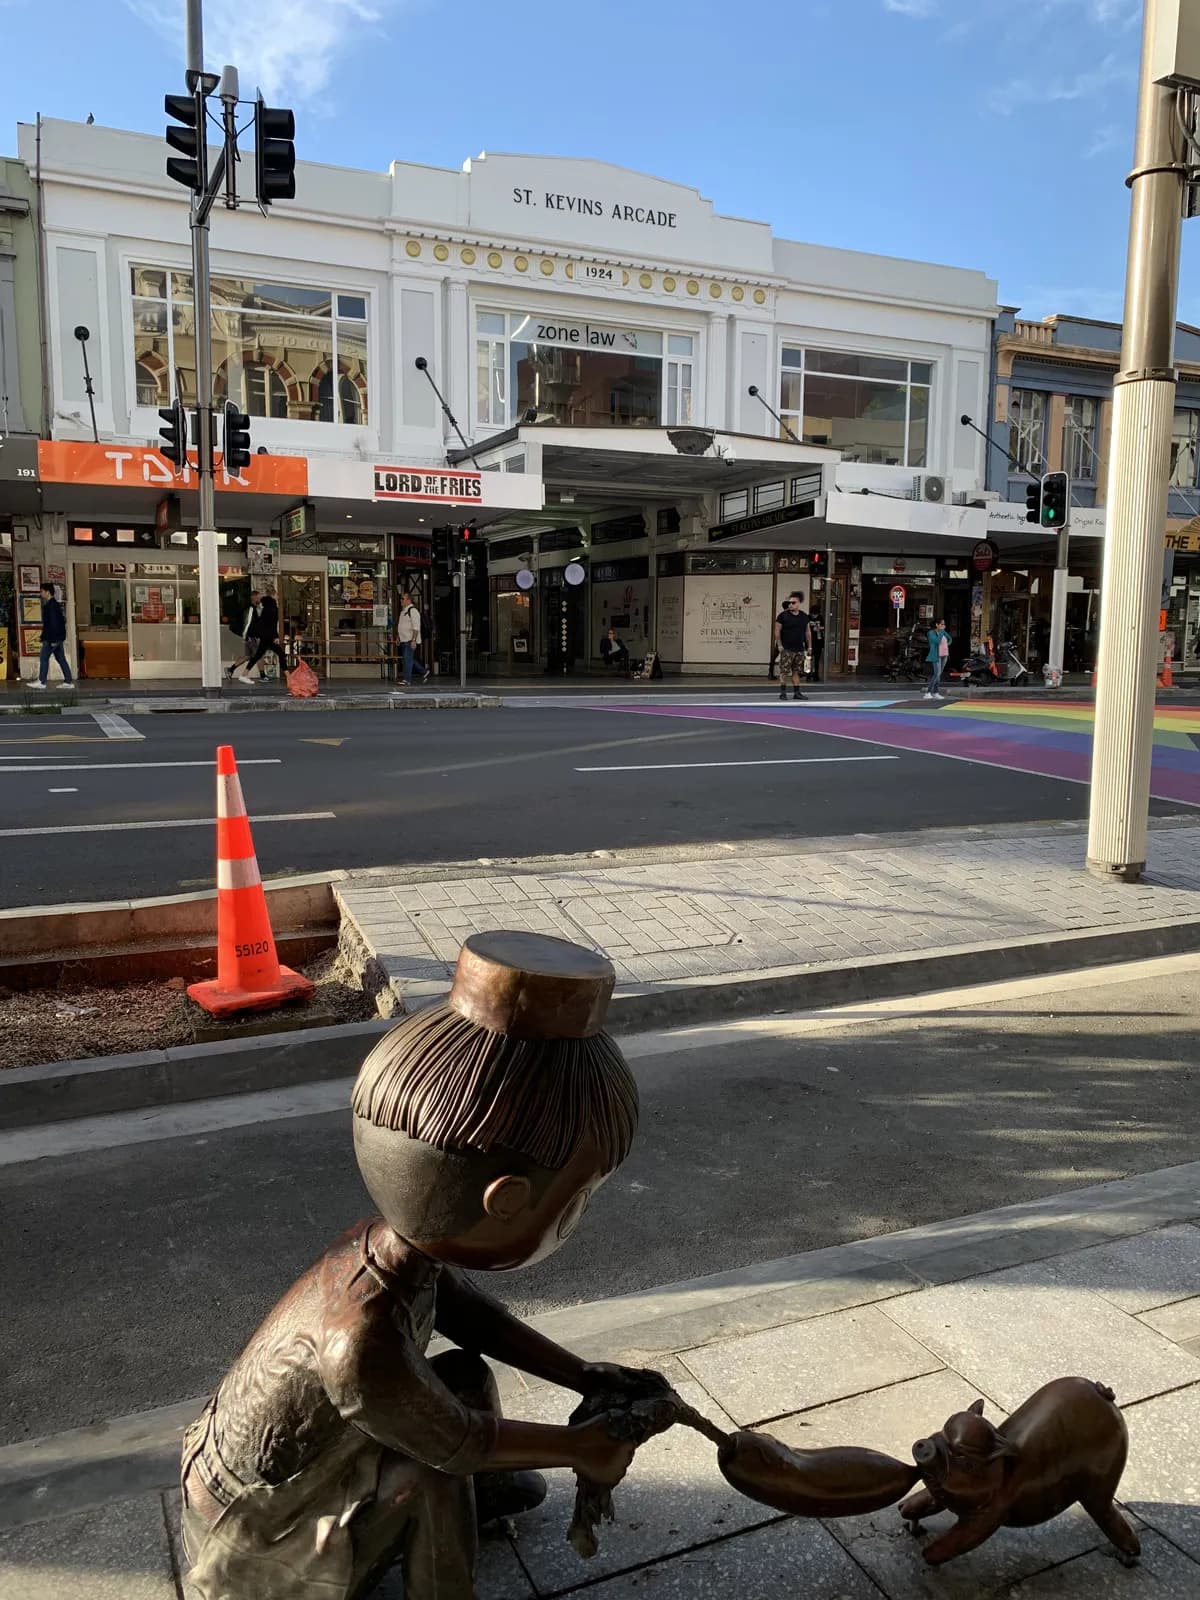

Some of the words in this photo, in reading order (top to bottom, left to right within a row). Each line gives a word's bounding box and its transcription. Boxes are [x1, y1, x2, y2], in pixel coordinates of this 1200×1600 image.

[513, 188, 537, 206] ST.
[545, 192, 603, 216] KEVINS
[612, 204, 678, 228] ARCADE
[585, 266, 613, 280] 1924
[537, 325, 580, 343] zone
[585, 326, 616, 347] law
[16, 468, 36, 478] 191
[426, 476, 438, 486] OF
[374, 472, 422, 493] LORD
[424, 485, 440, 494] THE
[440, 476, 481, 497] FRIES
[1165, 534, 1190, 550] THE
[235, 940, 269, 958] 55120
